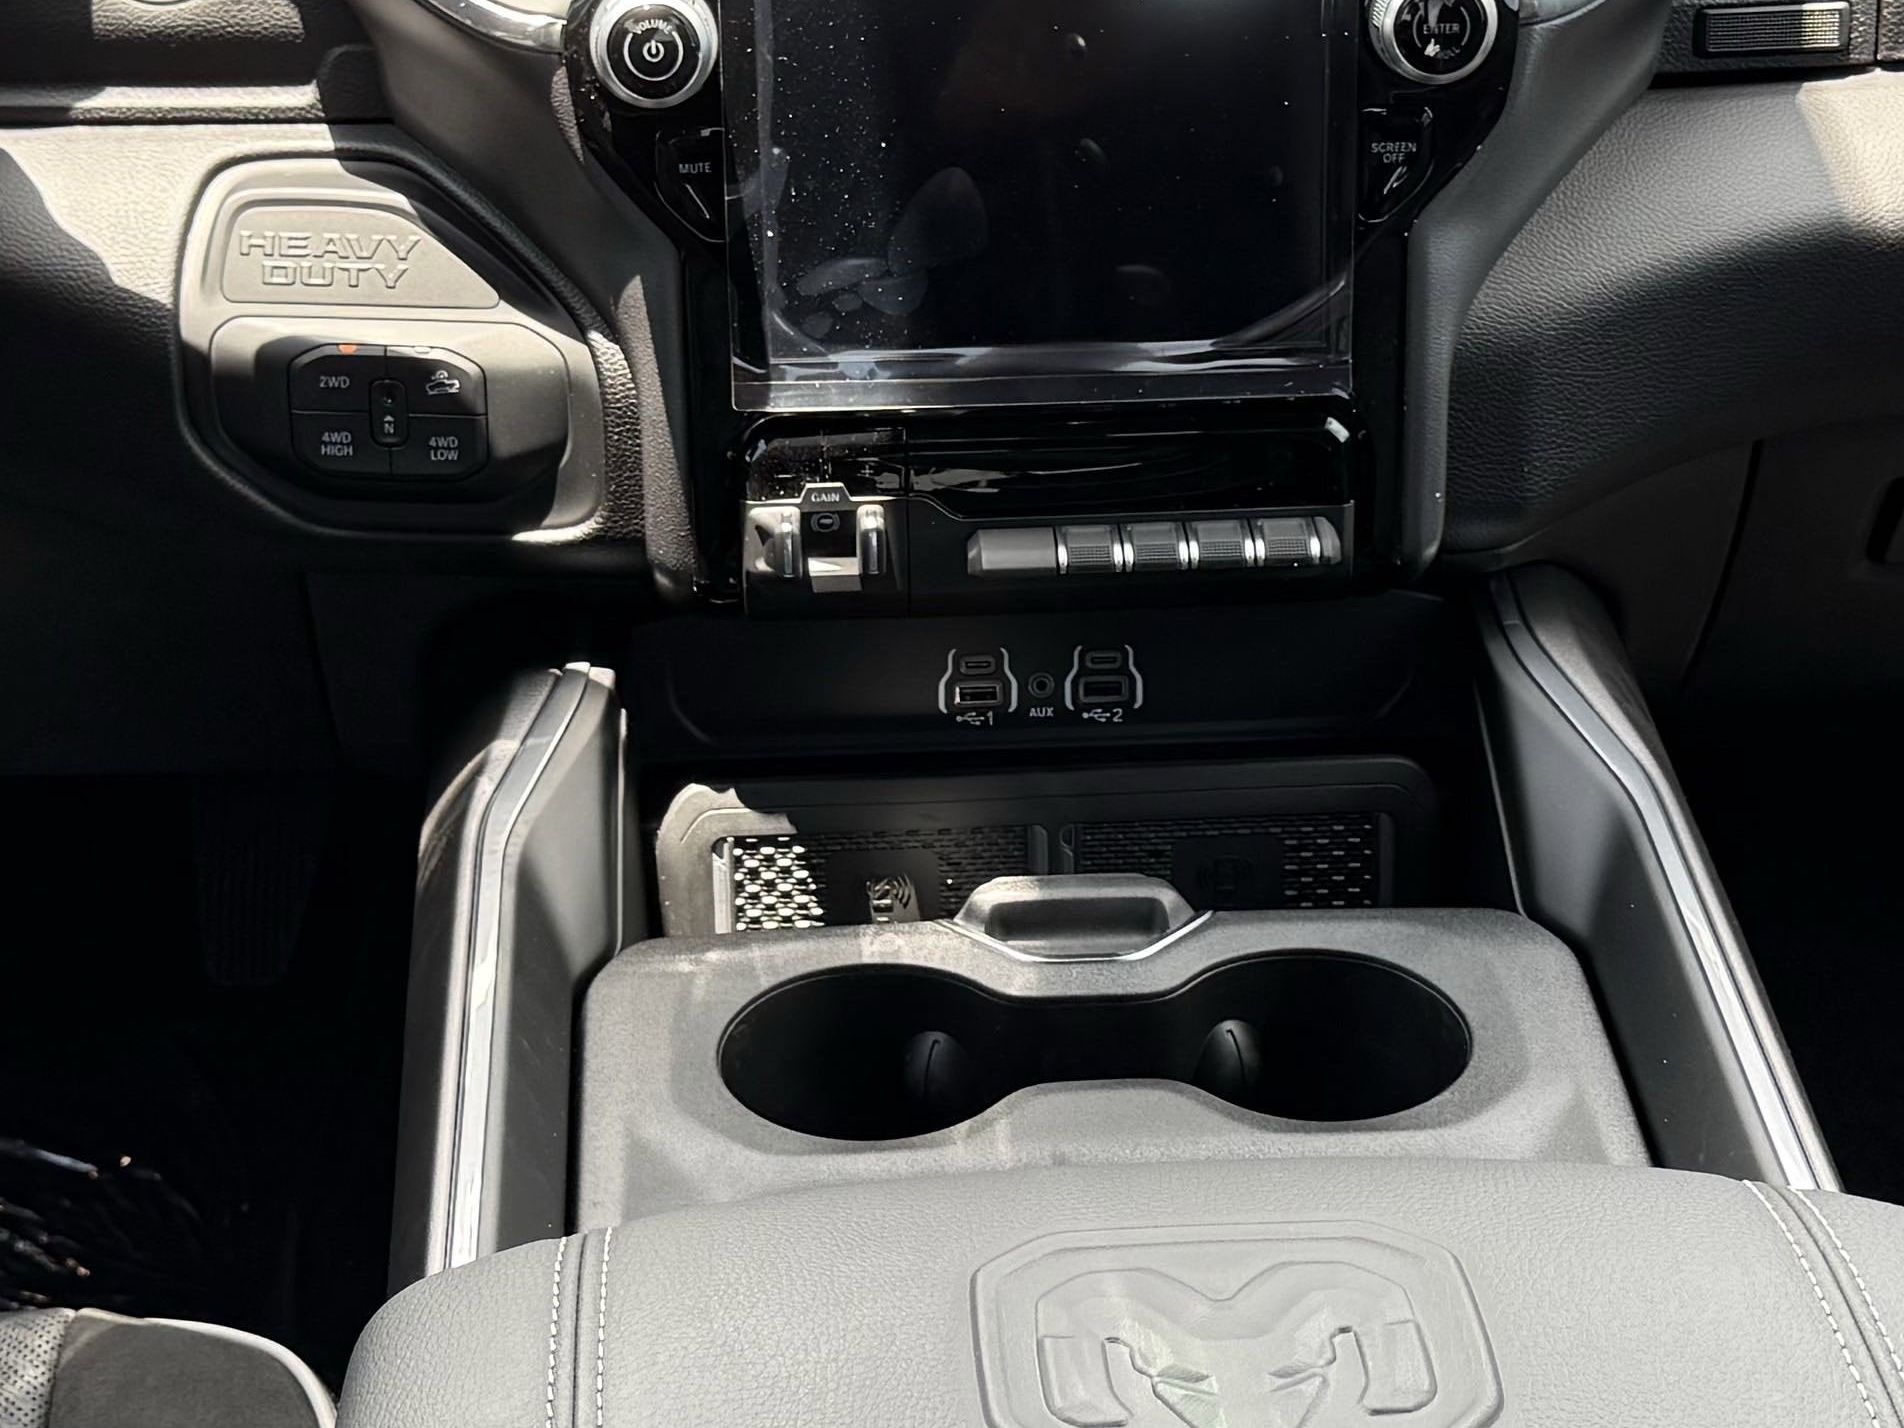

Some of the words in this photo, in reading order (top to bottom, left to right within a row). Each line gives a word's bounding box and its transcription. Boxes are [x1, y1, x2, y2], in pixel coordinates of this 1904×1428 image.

[632, 18, 675, 35] VOLUME
[1422, 22, 1461, 35] ENTER
[1370, 141, 1417, 153] SCREEN
[1382, 152, 1407, 164] OFF
[678, 161, 713, 175] MUTE
[238, 229, 422, 261] HEAVY
[261, 259, 409, 289] DUTY
[318, 375, 351, 389] 2WD
[383, 422, 395, 435] N
[321, 430, 353, 445] 4WD
[428, 435, 459, 449] 4WD
[320, 444, 354, 458] HIGH
[429, 448, 460, 462] LOW
[810, 491, 840, 503] GAIN
[1029, 707, 1055, 718] AUX
[1112, 708, 1123, 723] 2
